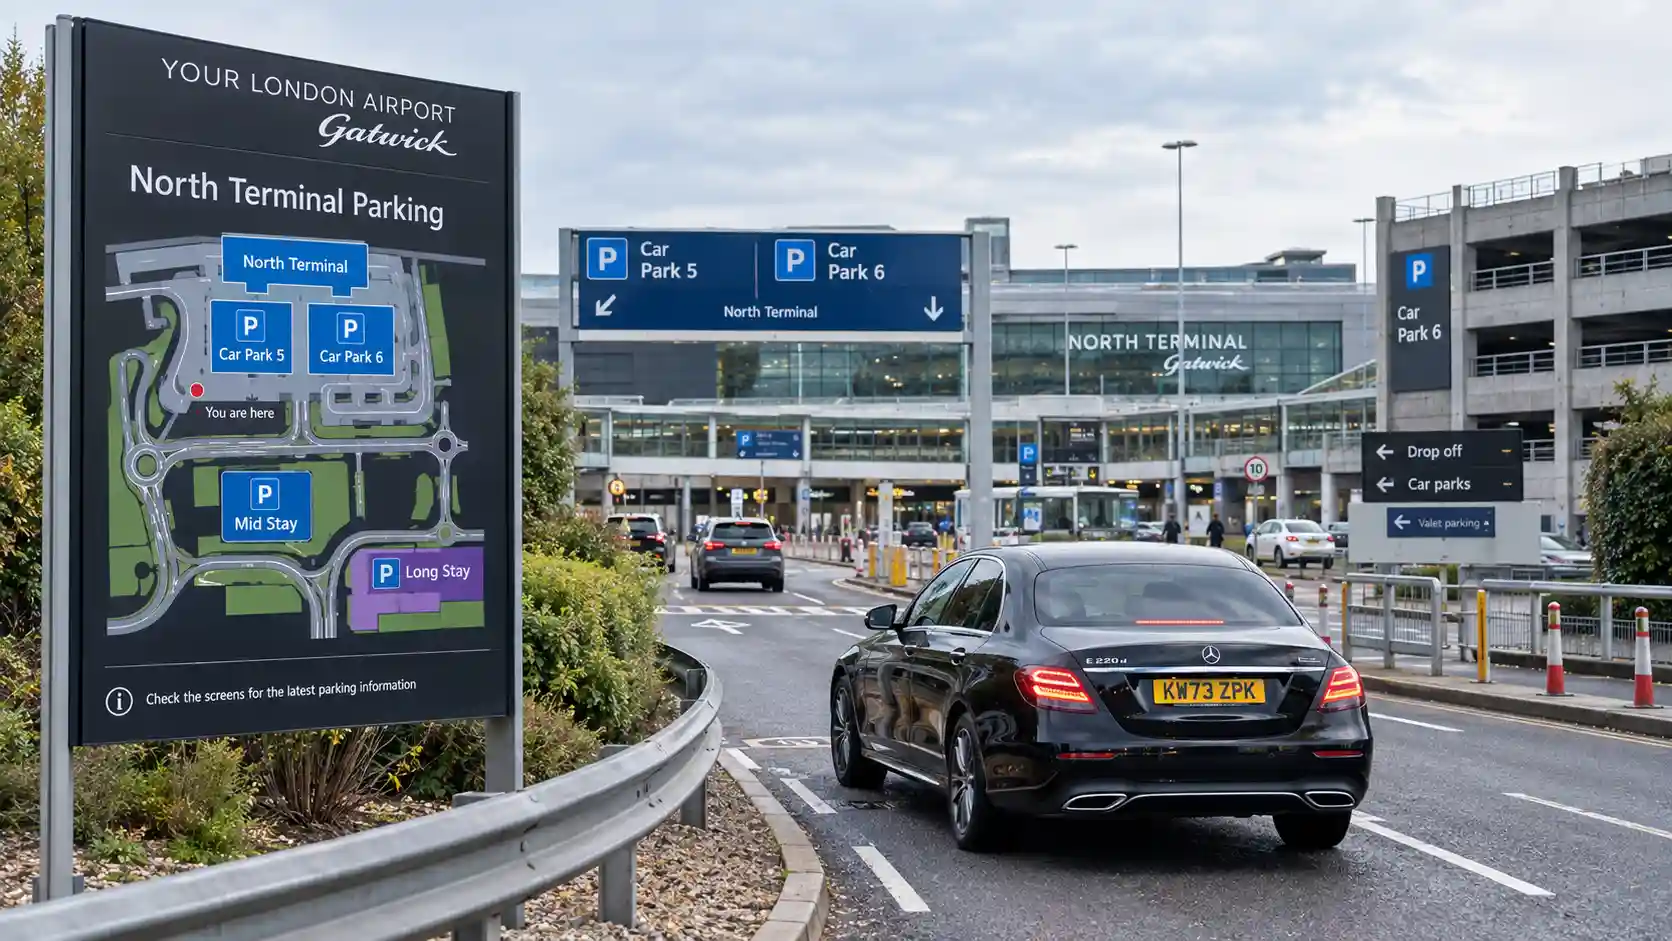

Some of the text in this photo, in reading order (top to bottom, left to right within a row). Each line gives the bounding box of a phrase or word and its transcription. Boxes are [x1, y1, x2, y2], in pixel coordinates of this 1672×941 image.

[162, 58, 456, 124] YOUR LONDON AIRPORT
[319, 109, 456, 155] Gatwick
[131, 165, 442, 230] North Terminal Parking
[641, 241, 669, 256] Car
[828, 243, 856, 258] Car
[244, 255, 347, 273] North Terminal
[599, 247, 616, 270] P
[788, 249, 804, 272] P
[642, 262, 697, 278] Park 5
[829, 264, 884, 280] Park 6
[1413, 260, 1426, 282] P
[724, 306, 817, 317] North Terminal
[1398, 306, 1420, 320] Car
[244, 316, 257, 335] P
[345, 319, 357, 338] P
[1399, 324, 1441, 342] Park 6
[1069, 334, 1247, 350] NORTH TERMINAL
[220, 348, 284, 361] Car Park 5
[320, 350, 383, 363] Car Park 6
[1164, 354, 1250, 376] Gatwick
[206, 407, 274, 418] You are here
[1408, 444, 1462, 460] Drop off
[1250, 464, 1263, 474] 10
[1409, 477, 1470, 492] Car parks
[259, 485, 272, 504] P
[235, 517, 297, 533] Mid Stay
[1418, 518, 1480, 530] Valet parking
[381, 564, 393, 583] P
[406, 564, 470, 581] Long Stay
[147, 680, 416, 705] Check the screens for the latest parking information
[1163, 681, 1256, 700] KW73 ZPK
